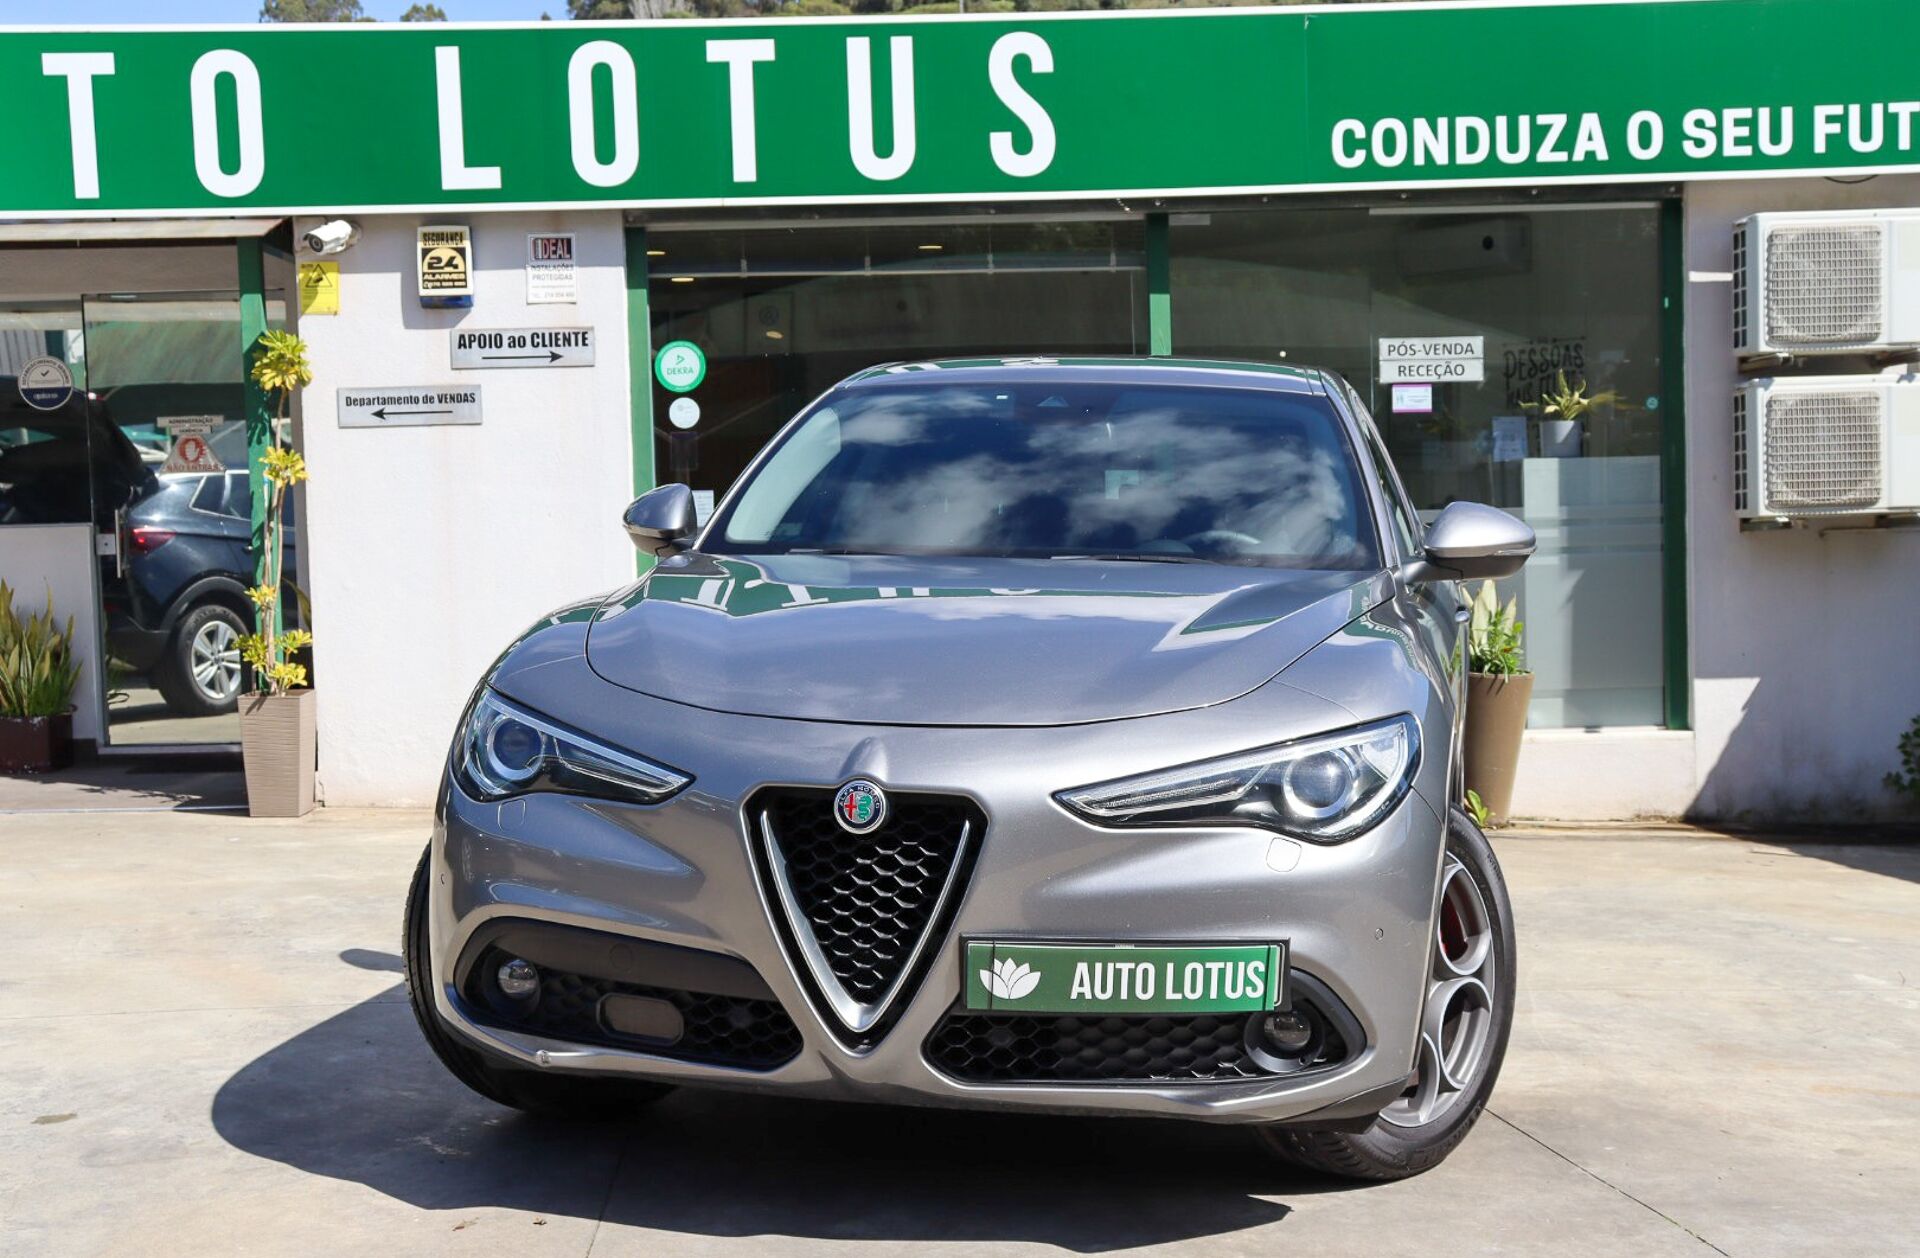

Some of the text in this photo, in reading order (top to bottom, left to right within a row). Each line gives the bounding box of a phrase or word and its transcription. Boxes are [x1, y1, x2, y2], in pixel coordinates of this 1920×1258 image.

[41, 31, 1057, 199] TO LOTUS
[1331, 101, 1920, 168] CONDUZA O SEU FUT
[427, 256, 459, 270] 24
[457, 331, 589, 349] APOIO ao CLIENTE
[1387, 341, 1475, 357] PÓS-VENDA
[666, 367, 694, 375] DEKRA
[1397, 361, 1465, 379] RECEÇÃO
[1503, 342, 1585, 382] PESSOAS
[345, 392, 476, 407] Departamento de VENDAS
[1070, 960, 1266, 1001] AUTO LOTUS
